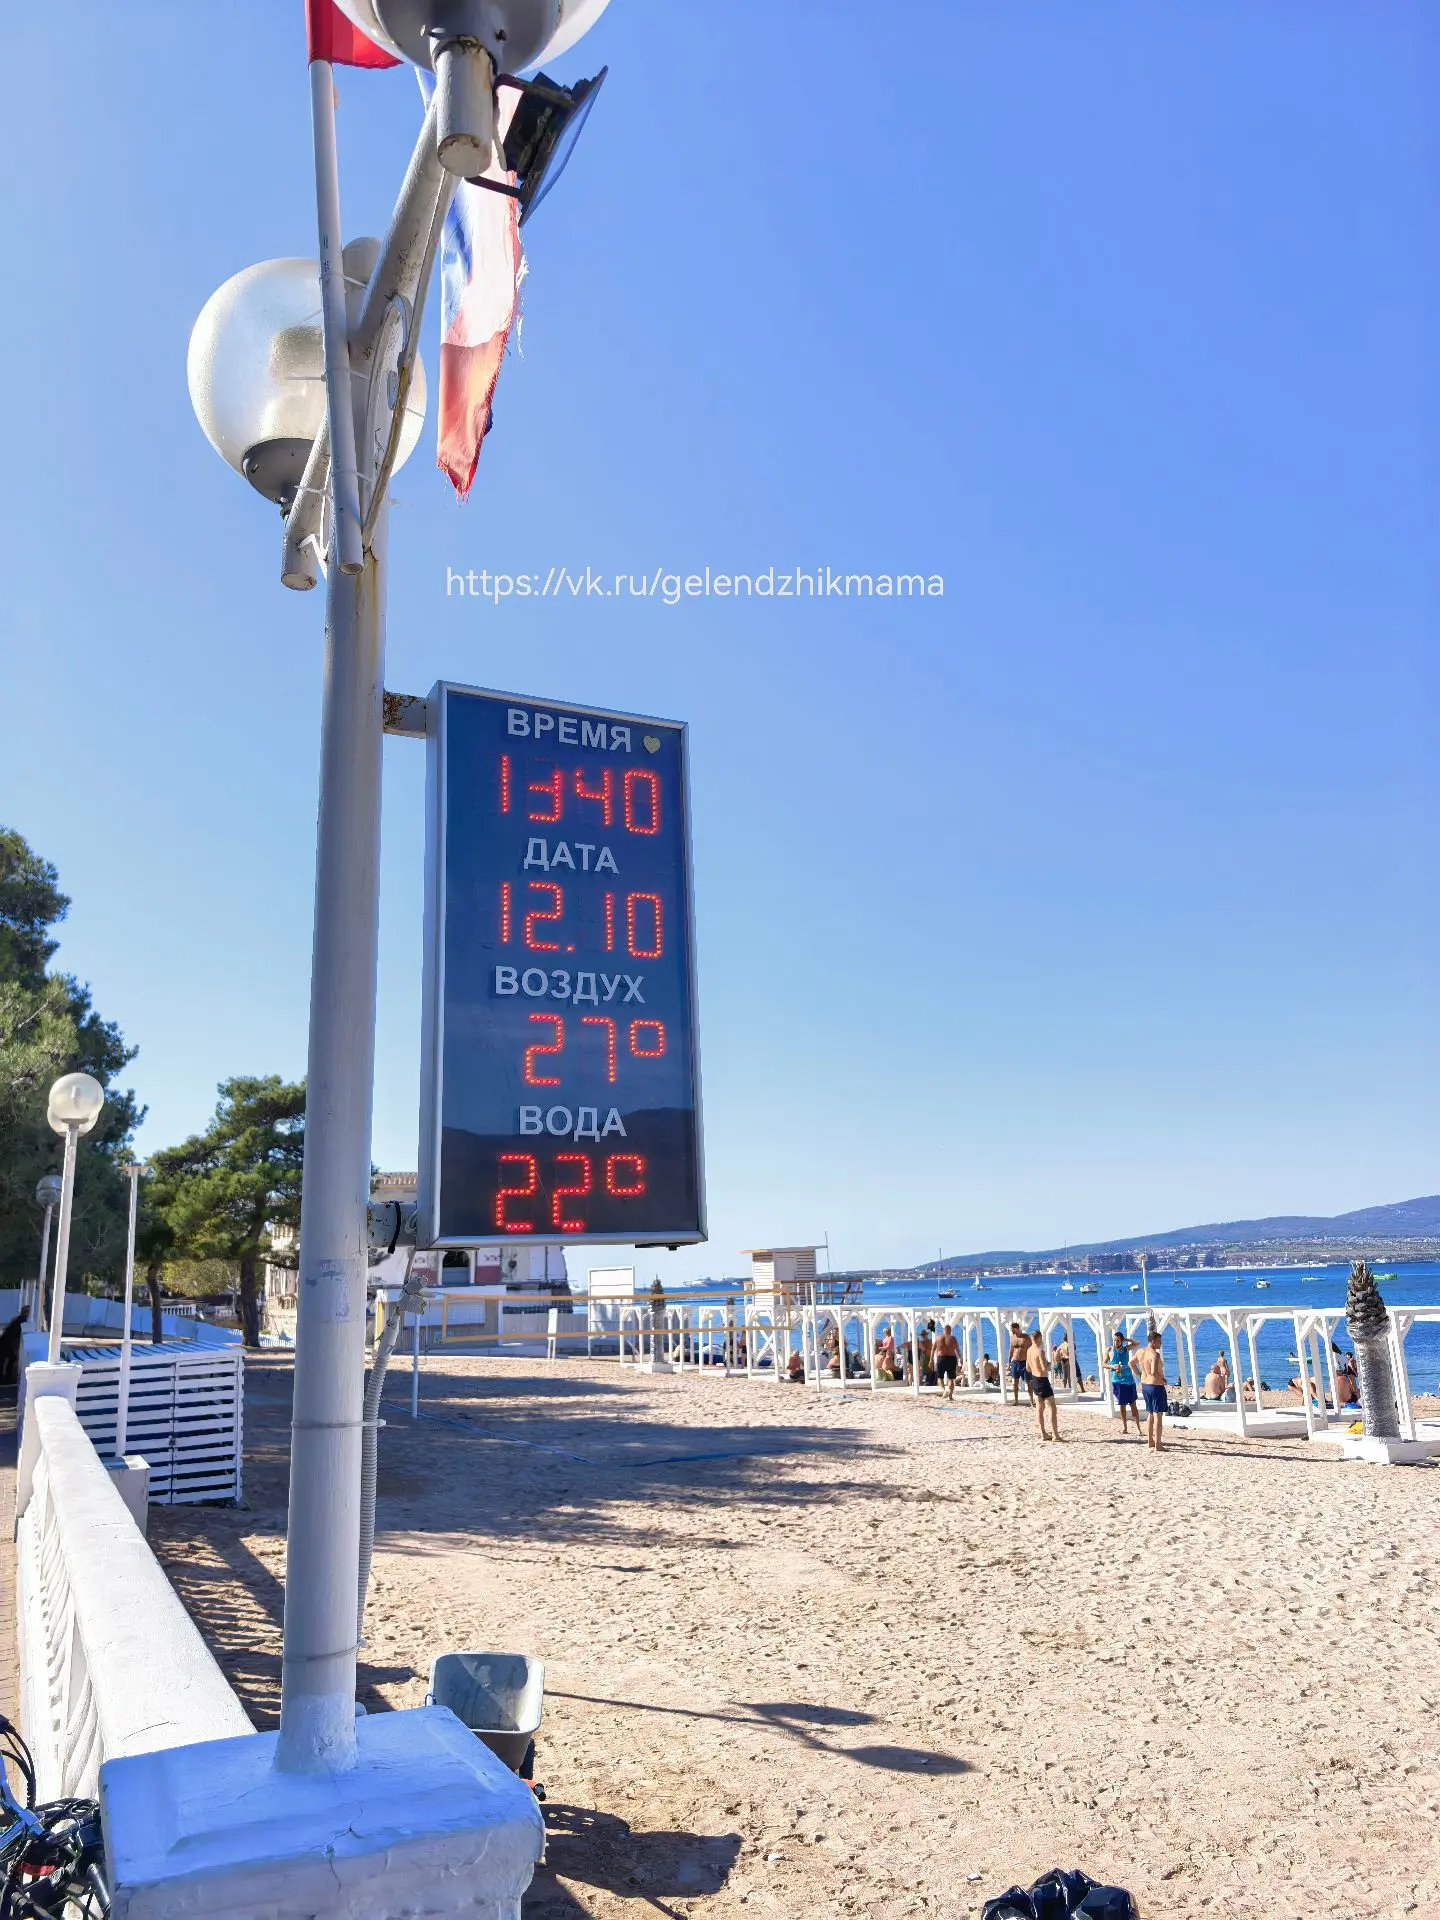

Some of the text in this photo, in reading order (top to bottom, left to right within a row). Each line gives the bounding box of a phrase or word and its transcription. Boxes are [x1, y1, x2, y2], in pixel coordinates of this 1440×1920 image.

[507, 708, 632, 753] ВРЕМЯ
[523, 837, 620, 875] ДАТА
[495, 965, 646, 1006] ВОЗДУХ
[519, 1105, 628, 1143] ВОДА
